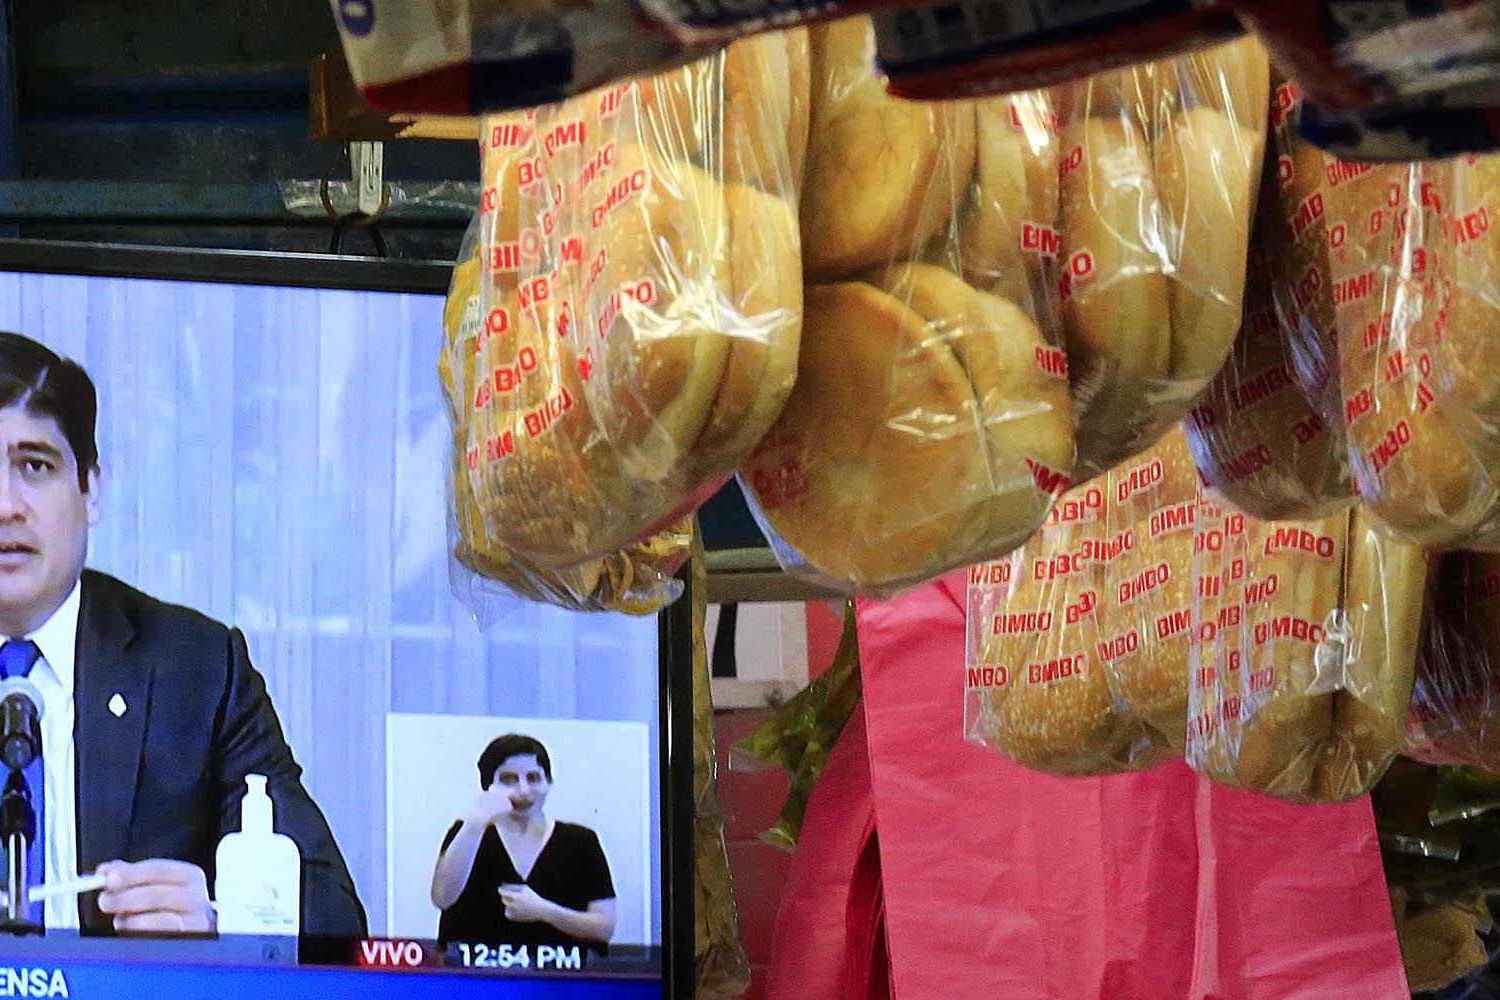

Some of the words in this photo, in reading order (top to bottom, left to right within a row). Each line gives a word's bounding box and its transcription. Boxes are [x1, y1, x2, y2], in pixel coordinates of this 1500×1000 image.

[361, 940, 423, 966] VIVO
[458, 943, 530, 970] 12:54
[537, 945, 581, 970] PM
